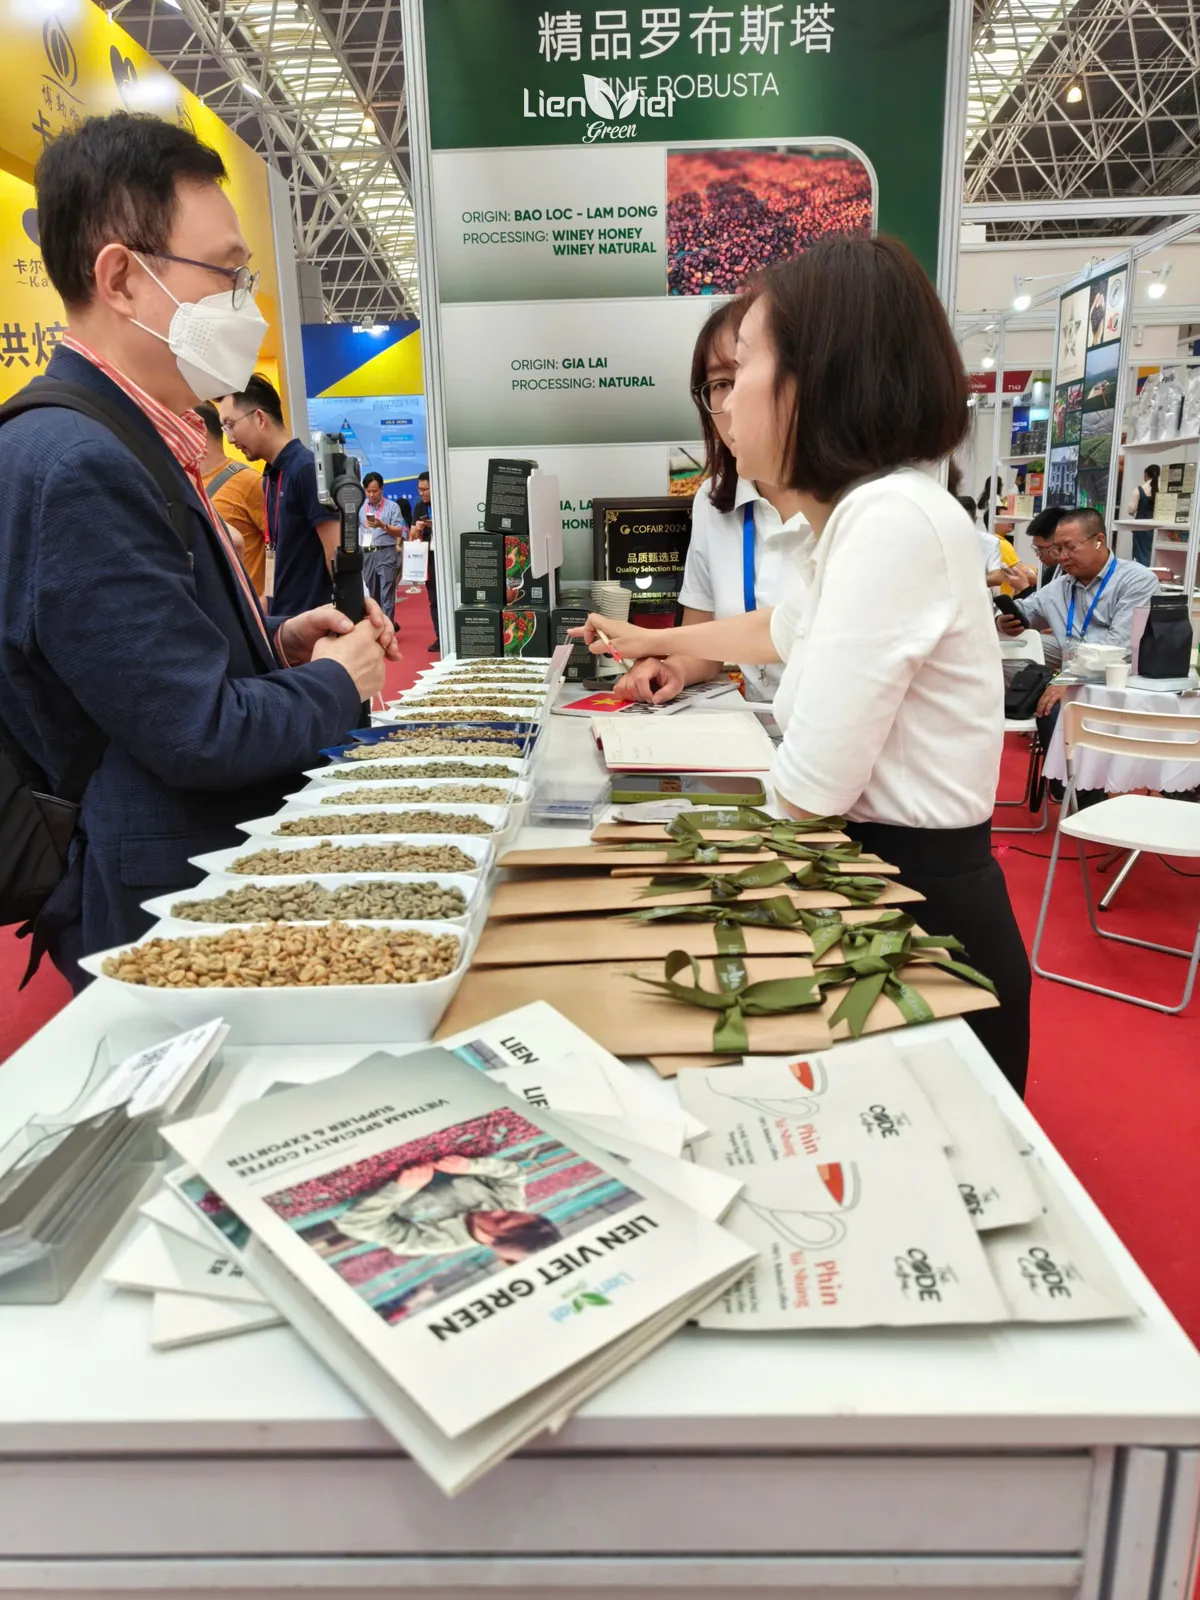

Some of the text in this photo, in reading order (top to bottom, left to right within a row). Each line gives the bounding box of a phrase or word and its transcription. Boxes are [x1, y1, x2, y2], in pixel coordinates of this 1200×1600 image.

[537, 2, 836, 62] 精品罗布斯塔
[656, 72, 780, 99] ROBUSTA
[461, 210, 511, 223] ORIGIN:
[514, 209, 543, 222] BAO
[546, 208, 573, 220] LOC
[586, 207, 614, 219] LAM
[617, 206, 658, 218] DONG
[463, 228, 643, 244] PROCESSING: WINEY HONEY
[552, 242, 657, 256] WINEY NATURAL
[511, 357, 608, 371] ORIGIN: GIA LAI
[512, 376, 656, 390] PROCESSING: NATURAL
[559, 500, 593, 512] IA, LA
[616, 565, 640, 574] Quality
[640, 565, 671, 573] Selection
[500, 1036, 540, 1065] LIEN
[523, 1086, 550, 1109] LIE
[328, 1104, 395, 1132] SUPPLIER
[226, 1133, 311, 1168] EXPORTER
[236, 1098, 450, 1178] VIETNAM SPECIALTY COFFEE
[796, 1123, 821, 1155] Phin
[596, 1214, 660, 1250] LIEN
[536, 1245, 603, 1286] VIET
[814, 1259, 842, 1306] Phin
[428, 1278, 535, 1341] GREEN
